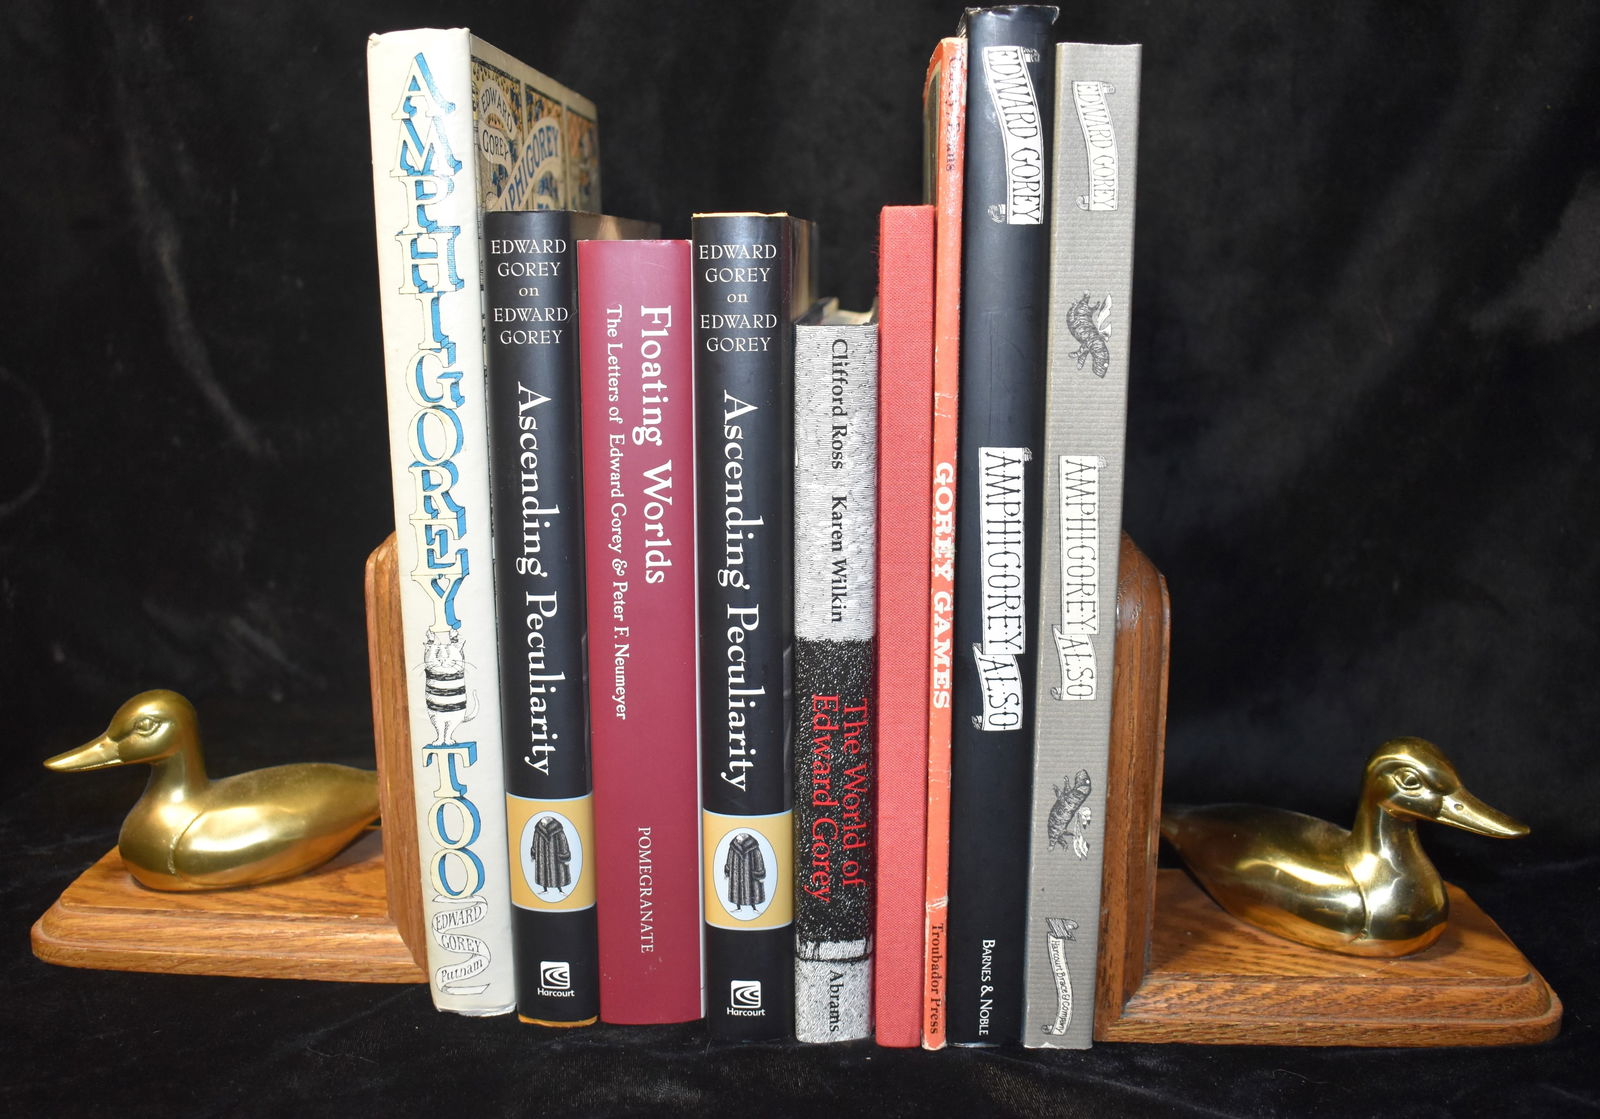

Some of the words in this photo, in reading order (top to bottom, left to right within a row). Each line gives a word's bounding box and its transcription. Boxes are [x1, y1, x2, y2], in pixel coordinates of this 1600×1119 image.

[481, 87, 513, 133] EDWARD
[987, 49, 1038, 139] EDWARD
[1076, 83, 1113, 149] EDWARD
[482, 129, 509, 161] GOREY
[1011, 147, 1041, 222] GOREY
[1092, 155, 1115, 209] GOREY
[491, 239, 567, 254] EDWARD
[497, 262, 561, 277] GOREY
[698, 244, 777, 260] EDWARD
[518, 286, 539, 297] on
[705, 267, 771, 283] GOREY
[726, 292, 748, 303] on
[493, 307, 569, 323] EDWARD
[500, 330, 563, 345] GOREY
[606, 304, 623, 338] The
[700, 314, 778, 330] EDWARD
[390, 52, 470, 633] AMPHIGOREY
[706, 337, 771, 353] GOREY
[607, 342, 624, 403] Letters
[632, 305, 672, 447] Floating
[831, 339, 848, 417] Clifford
[608, 406, 623, 425] of
[609, 433, 625, 498] Edward
[831, 423, 848, 470] Ross
[516, 381, 561, 578] Ascending
[717, 389, 764, 590] Ascending
[608, 502, 627, 554] Gorey
[643, 459, 673, 585] Worlds
[831, 495, 848, 553] Karen
[933, 462, 954, 582] GOREY
[1065, 459, 1097, 631] AMPHIGOREY
[612, 559, 628, 577] &
[985, 452, 1022, 650] AMPHIGOREY
[613, 582, 629, 627] Peter
[831, 558, 848, 623] Wilkin
[614, 626, 629, 638] F.
[932, 591, 952, 709] GAMES
[524, 591, 566, 776] Peculiarity
[611, 643, 630, 721] Neumeyer
[978, 656, 1021, 730] ALSO
[1058, 635, 1094, 699] ALSO
[720, 603, 766, 792] Peculiarity
[812, 694, 839, 808] Edward
[843, 698, 869, 755] The
[422, 741, 486, 898] TOO
[843, 763, 869, 850] World
[804, 817, 839, 903] Gorey
[842, 861, 867, 888] of
[637, 826, 655, 954] POMEGRANATE
[435, 906, 482, 931] EDWARD
[441, 934, 481, 953] GOREY
[441, 959, 483, 983] Putnam
[930, 923, 944, 995] Troubador
[980, 939, 996, 982] BARNES
[1051, 940, 1063, 972] Harcourt
[537, 988, 576, 998] Harcourt
[829, 969, 845, 1033] Abrams
[980, 985, 994, 998] &
[1056, 972, 1068, 993] Brace
[726, 1006, 766, 1017] Harcourt
[929, 998, 942, 1035] Press
[978, 999, 993, 1037] NOBLE
[1055, 1001, 1070, 1034] Company
